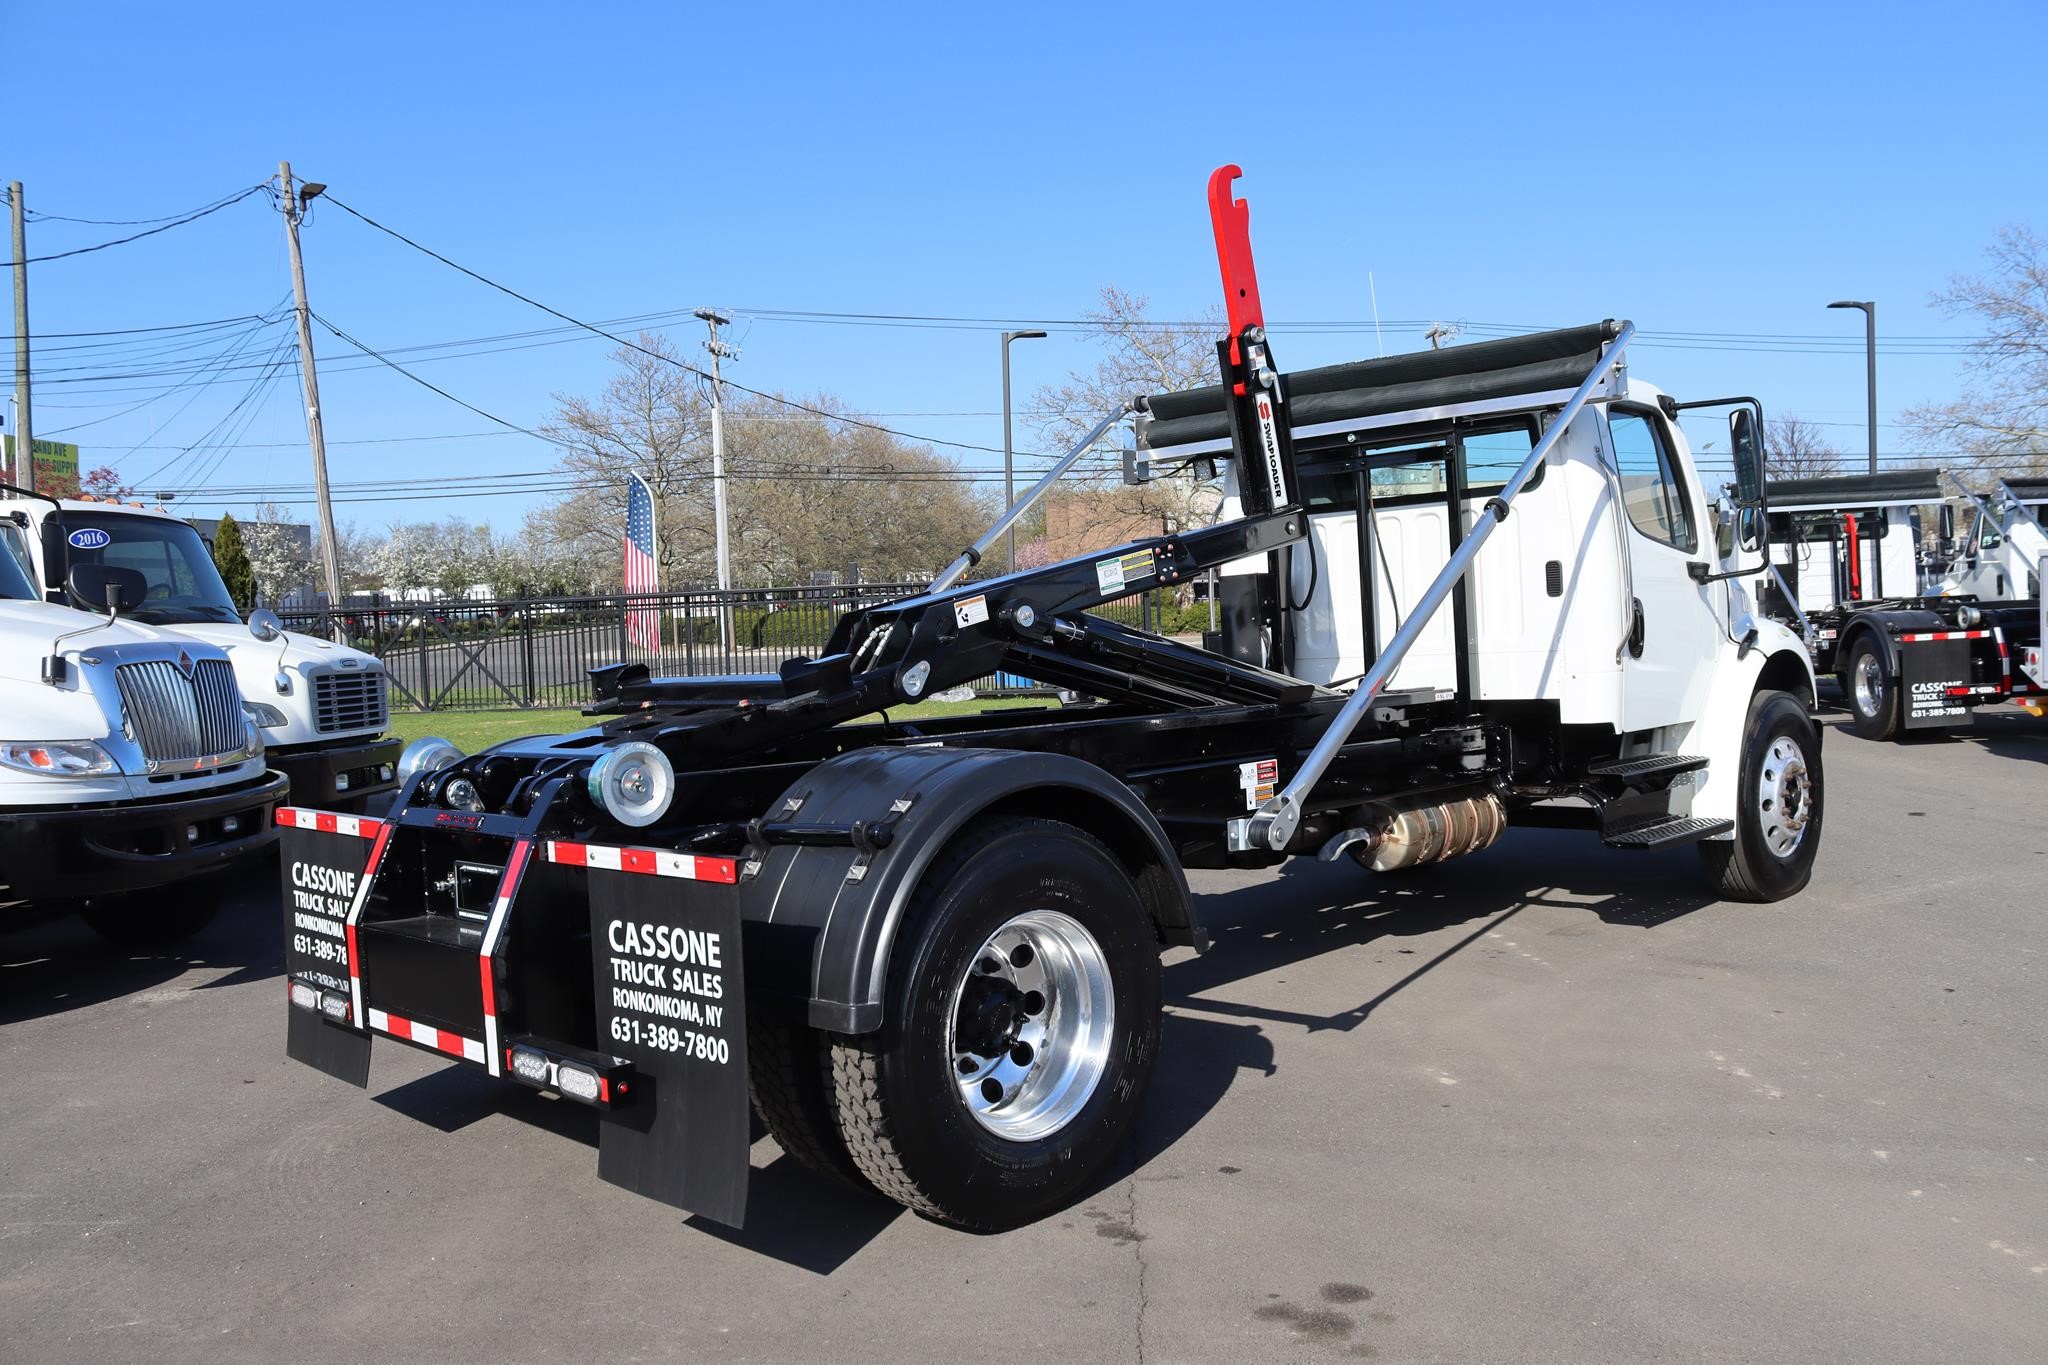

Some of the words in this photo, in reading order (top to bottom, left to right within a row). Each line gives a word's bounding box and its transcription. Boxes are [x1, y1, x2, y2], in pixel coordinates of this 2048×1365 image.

[1263, 422, 1282, 498] SWAPLOADER
[77, 531, 104, 546] 2016
[1911, 707, 1966, 718] 631-389-7800
[1912, 693, 1938, 701] TRUCK
[292, 861, 355, 898] CASSONE
[293, 890, 326, 914] TRUCK
[327, 898, 350, 919] SALE
[294, 934, 348, 966] 631-389-78
[608, 920, 722, 969] CASSONE
[610, 957, 667, 989] TRUCK
[672, 967, 723, 999] SALES
[612, 986, 704, 1027] RONKONKOMA,
[705, 1004, 723, 1028] NY
[610, 1016, 729, 1065] 631-389-7800
